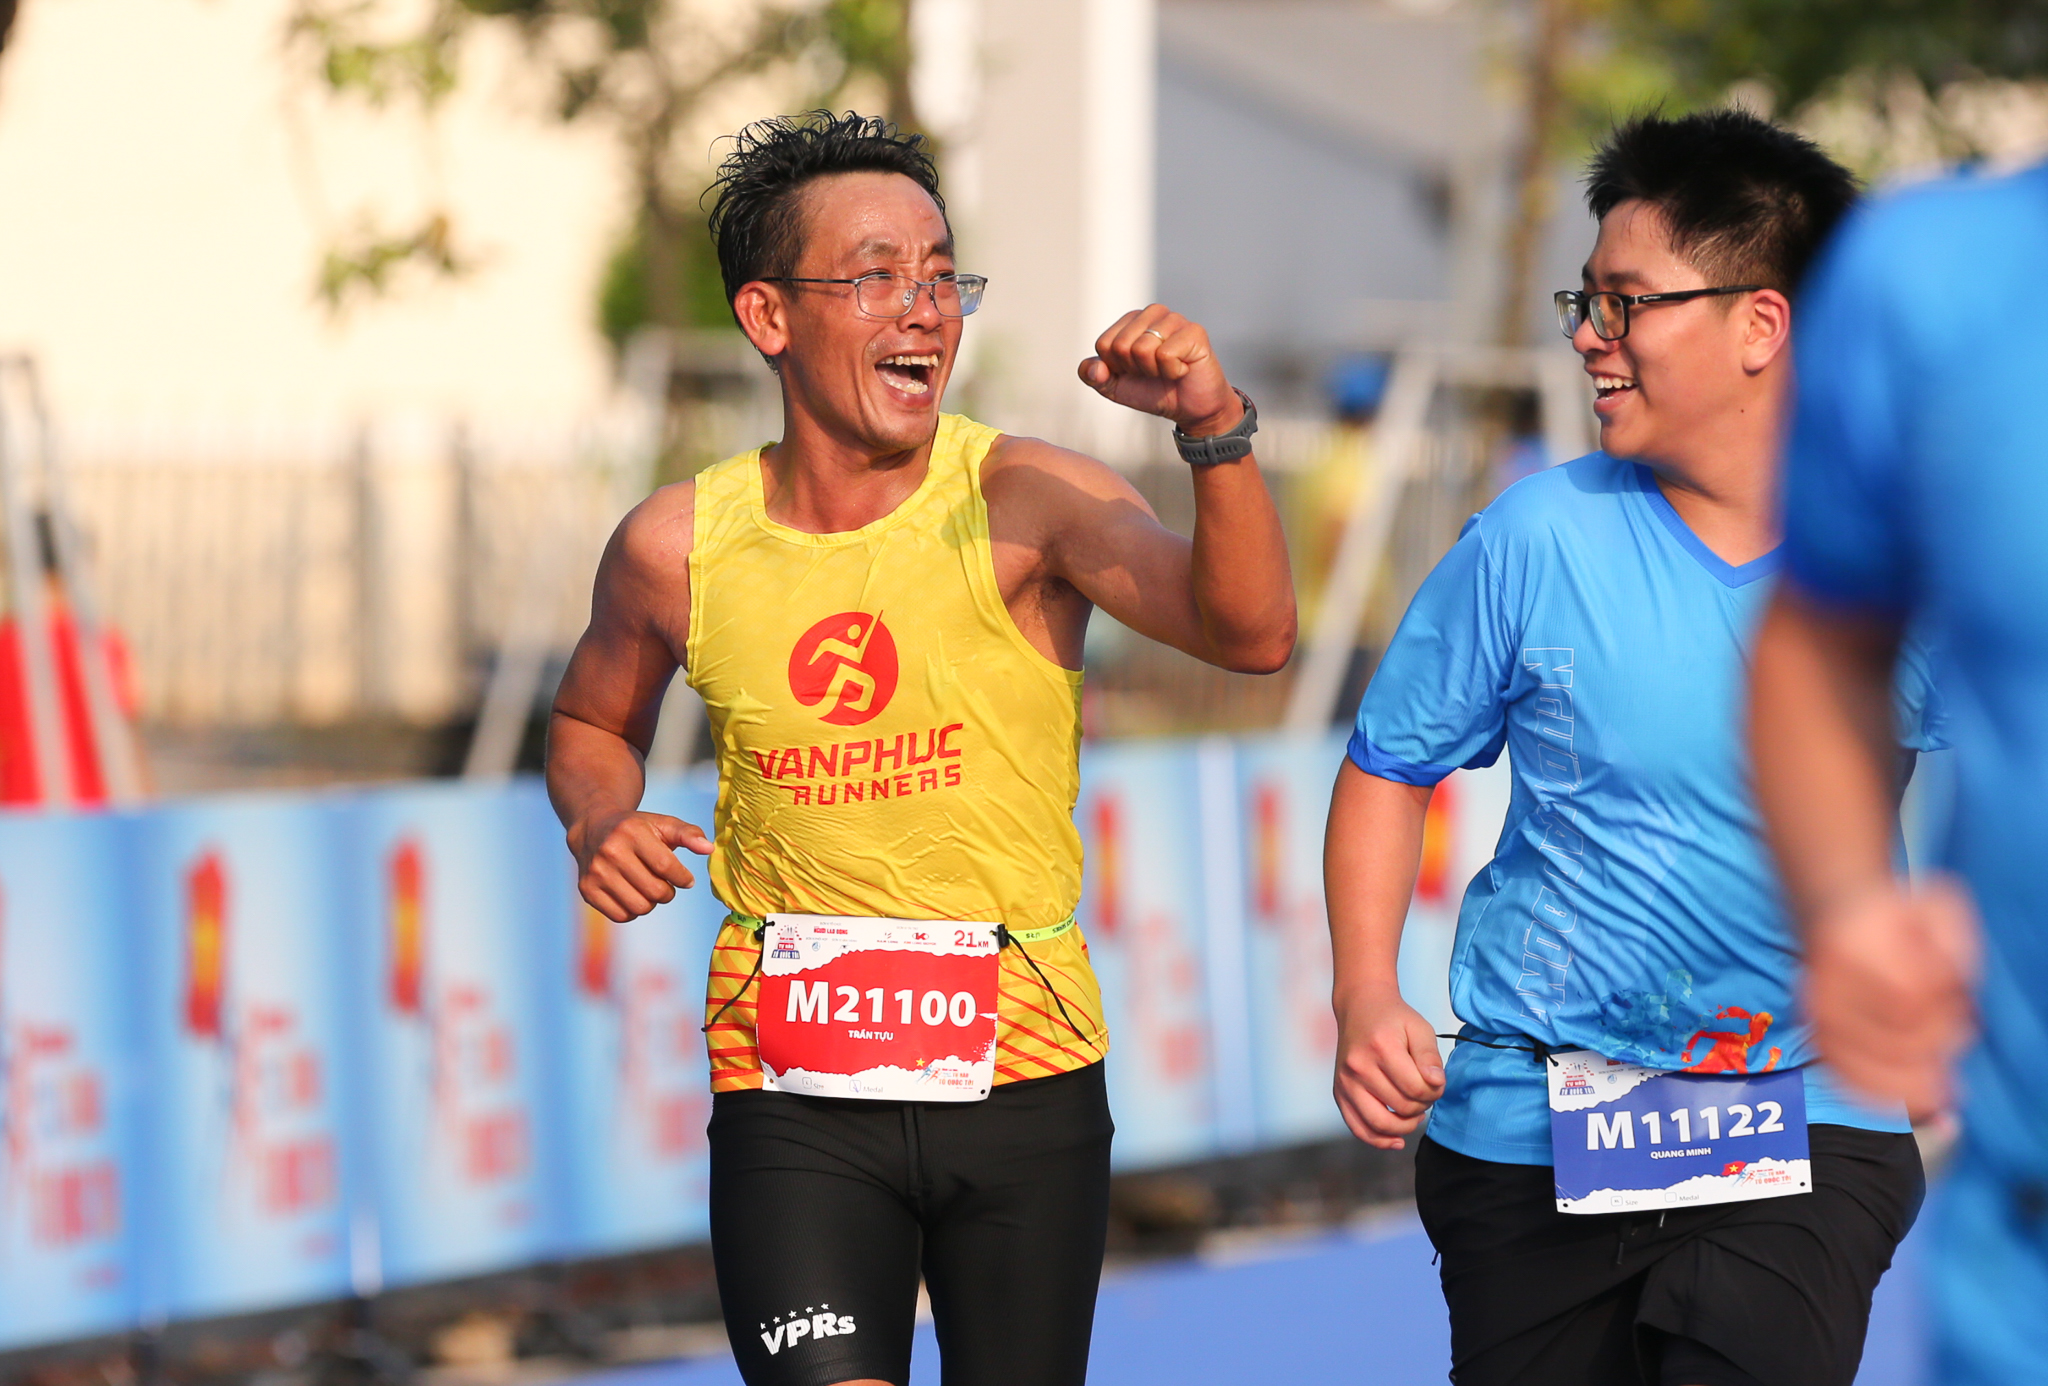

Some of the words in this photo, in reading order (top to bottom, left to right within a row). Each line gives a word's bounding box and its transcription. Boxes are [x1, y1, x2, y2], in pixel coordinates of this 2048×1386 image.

[750, 723, 963, 779] VANPHUC
[779, 763, 961, 805] RUNNERS
[786, 980, 976, 1027] M21100
[1586, 1101, 1785, 1150] M11122
[1650, 1150, 1685, 1160] QUANG
[1686, 1147, 1712, 1156] MINH
[760, 1312, 856, 1356] VPRs
